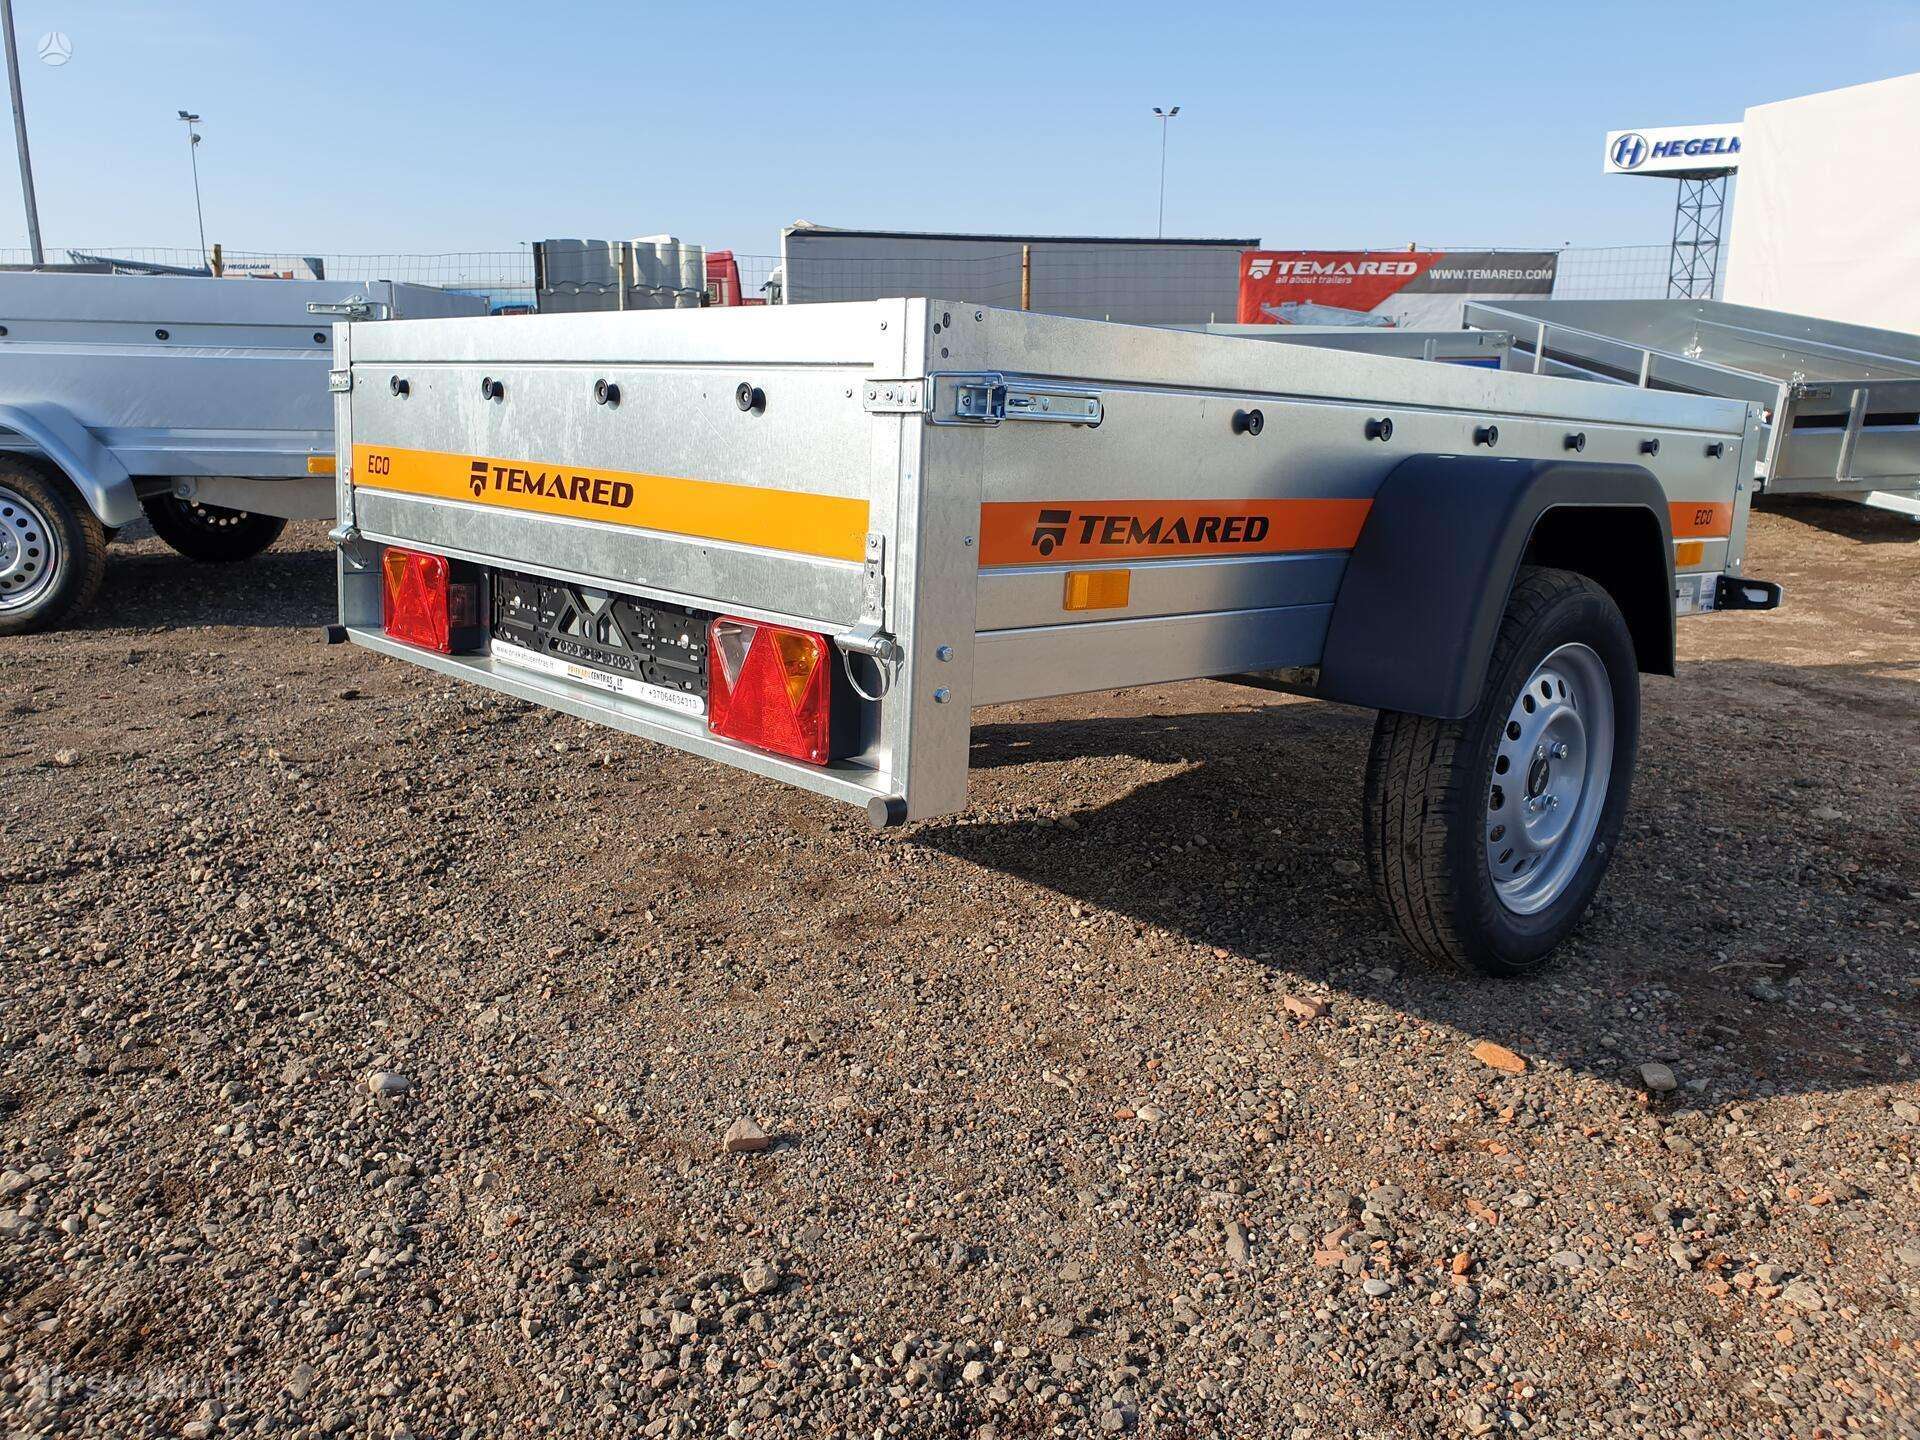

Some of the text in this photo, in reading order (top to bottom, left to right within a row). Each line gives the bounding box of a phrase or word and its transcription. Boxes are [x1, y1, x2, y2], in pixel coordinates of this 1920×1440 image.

[1277, 261, 1418, 276] TEMARED
[1429, 268, 1553, 280] WWW.TEMARED.COM
[1275, 275, 1353, 284] all about trailers
[368, 454, 634, 509] ECO TEMARED
[1694, 509, 1713, 526] ECO
[1078, 515, 1269, 545] TEMARED
